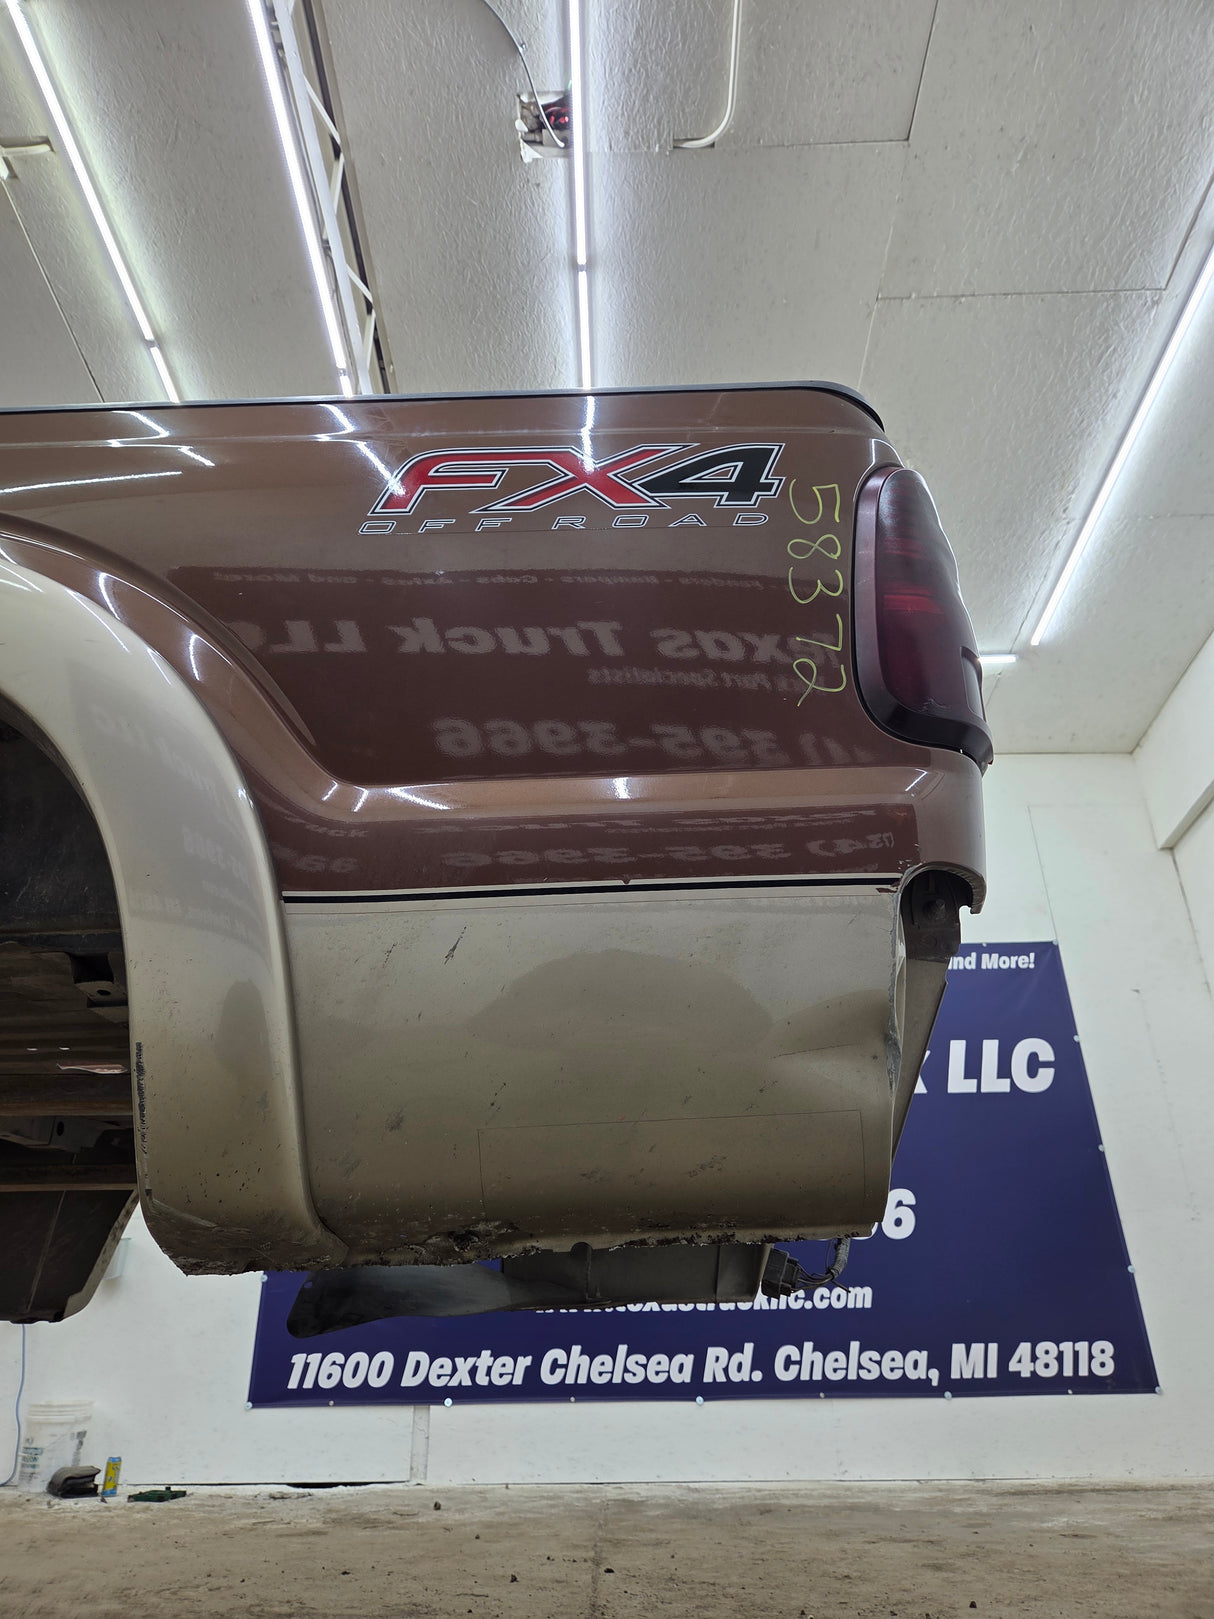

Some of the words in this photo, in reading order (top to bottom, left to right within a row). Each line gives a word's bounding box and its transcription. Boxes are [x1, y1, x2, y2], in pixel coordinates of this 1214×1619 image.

[366, 443, 786, 516] FX4
[358, 517, 513, 535] OFF
[551, 513, 769, 530] ROAD
[787, 478, 847, 707] 58372
[981, 952, 1035, 969] More!
[947, 1037, 1055, 1094] LLC
[287, 1351, 394, 1389] 11600
[401, 1350, 532, 1387] Dexter
[540, 1344, 694, 1384] Chelsea
[703, 1342, 763, 1383] Rd.
[774, 1341, 939, 1387] Chelsea,
[950, 1342, 998, 1379] MI
[1008, 1341, 1115, 1378] 48118
